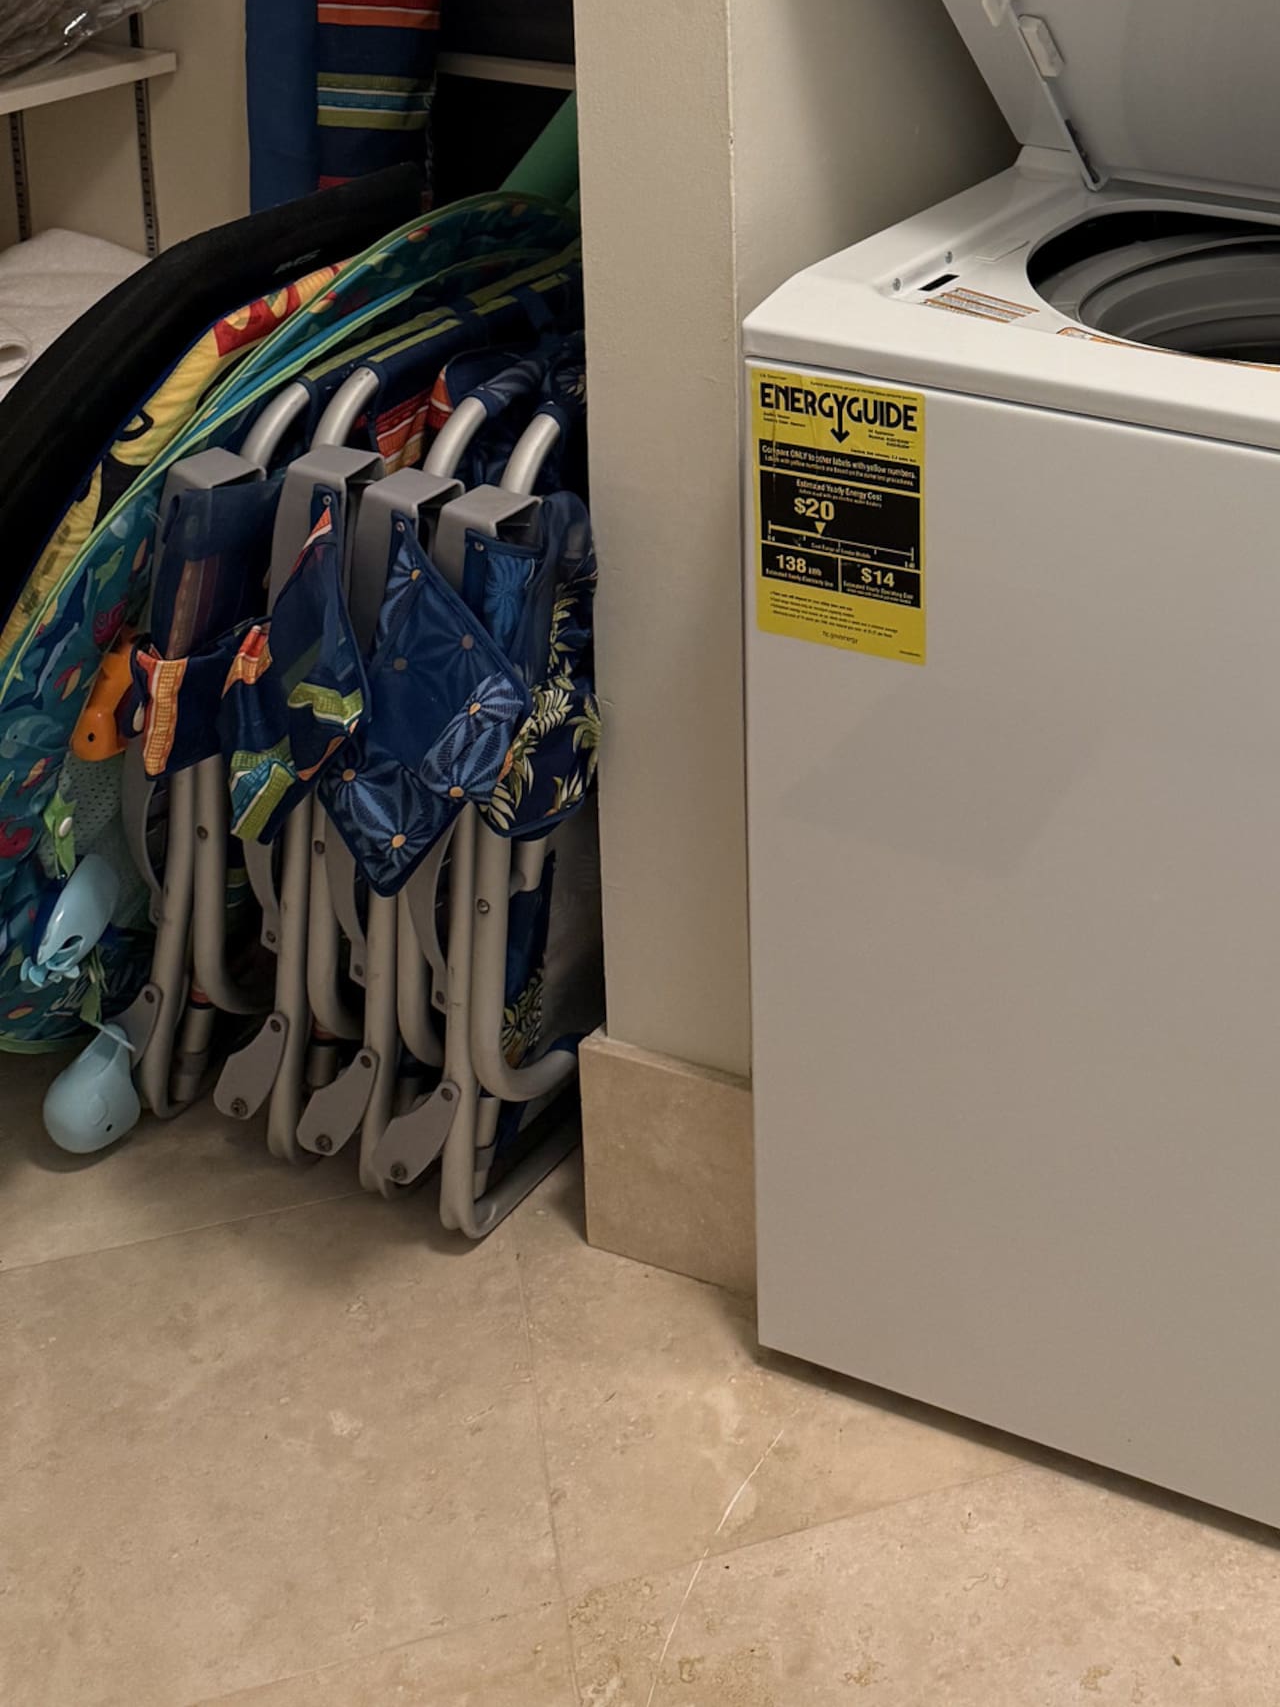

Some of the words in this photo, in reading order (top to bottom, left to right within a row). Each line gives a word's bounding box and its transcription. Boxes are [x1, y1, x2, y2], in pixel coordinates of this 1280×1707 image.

[761, 382, 917, 432] ENERGYGUIDE
[794, 497, 835, 521] $20
[776, 554, 807, 574] 138
[861, 566, 895, 588] $14
